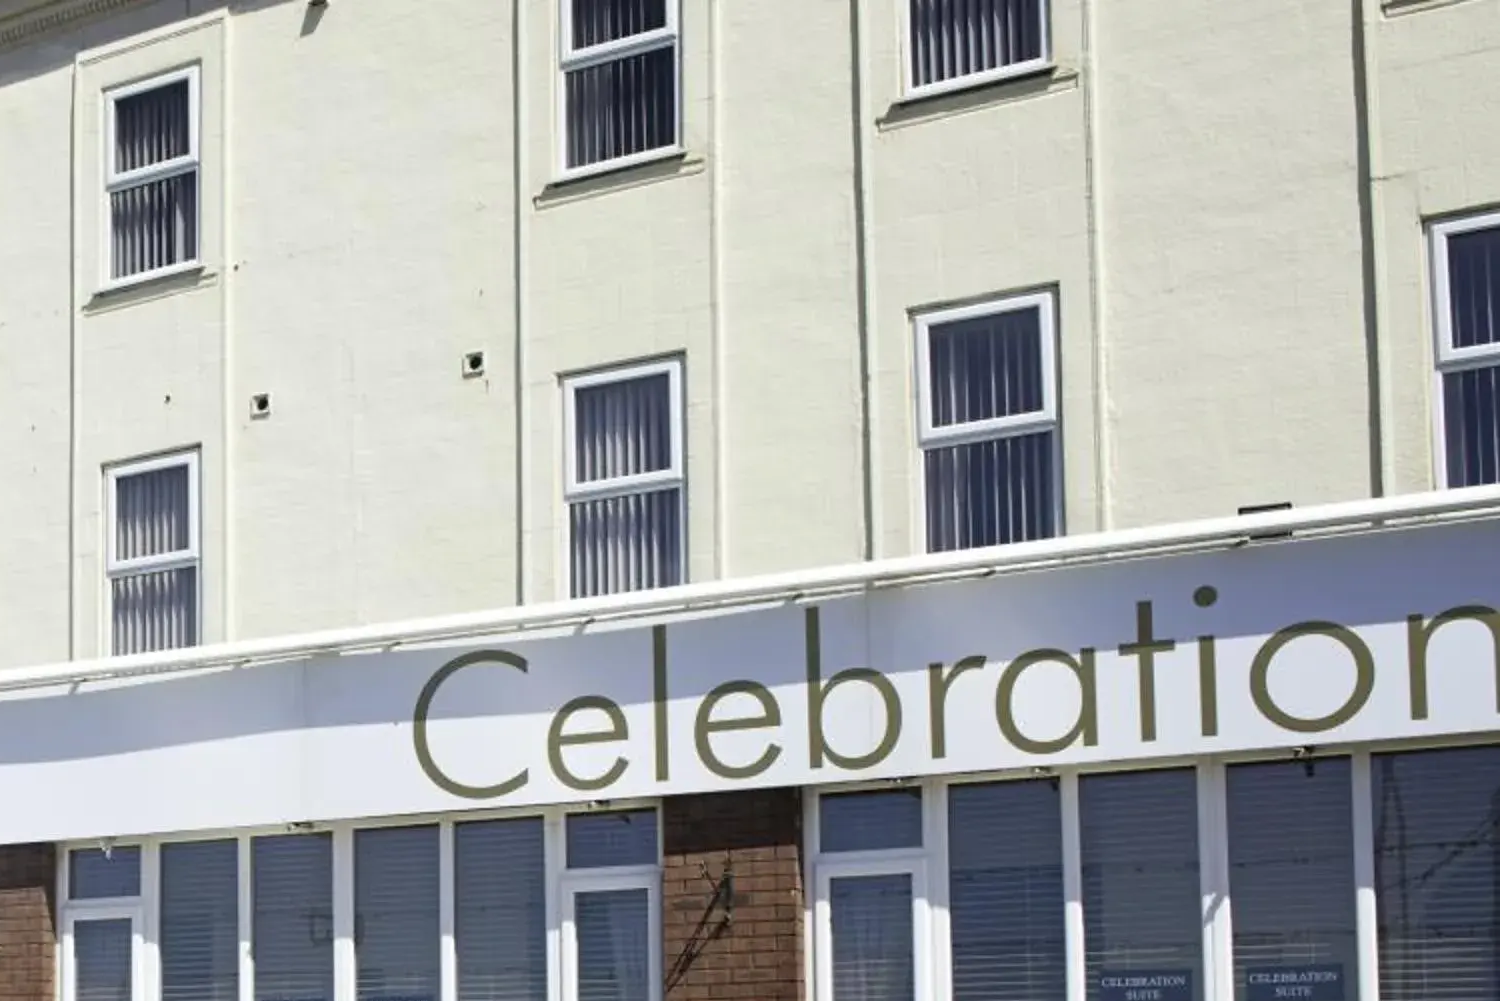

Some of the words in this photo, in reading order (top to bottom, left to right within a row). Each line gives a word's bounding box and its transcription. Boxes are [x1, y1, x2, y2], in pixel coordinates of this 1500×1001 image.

[411, 585, 1500, 800] Celebration
[1101, 975, 1187, 988] CELEBRATION
[1249, 971, 1338, 985] CELEBRATION
[1124, 988, 1162, 1001] SUITE
[1274, 985, 1313, 998] SUITE
